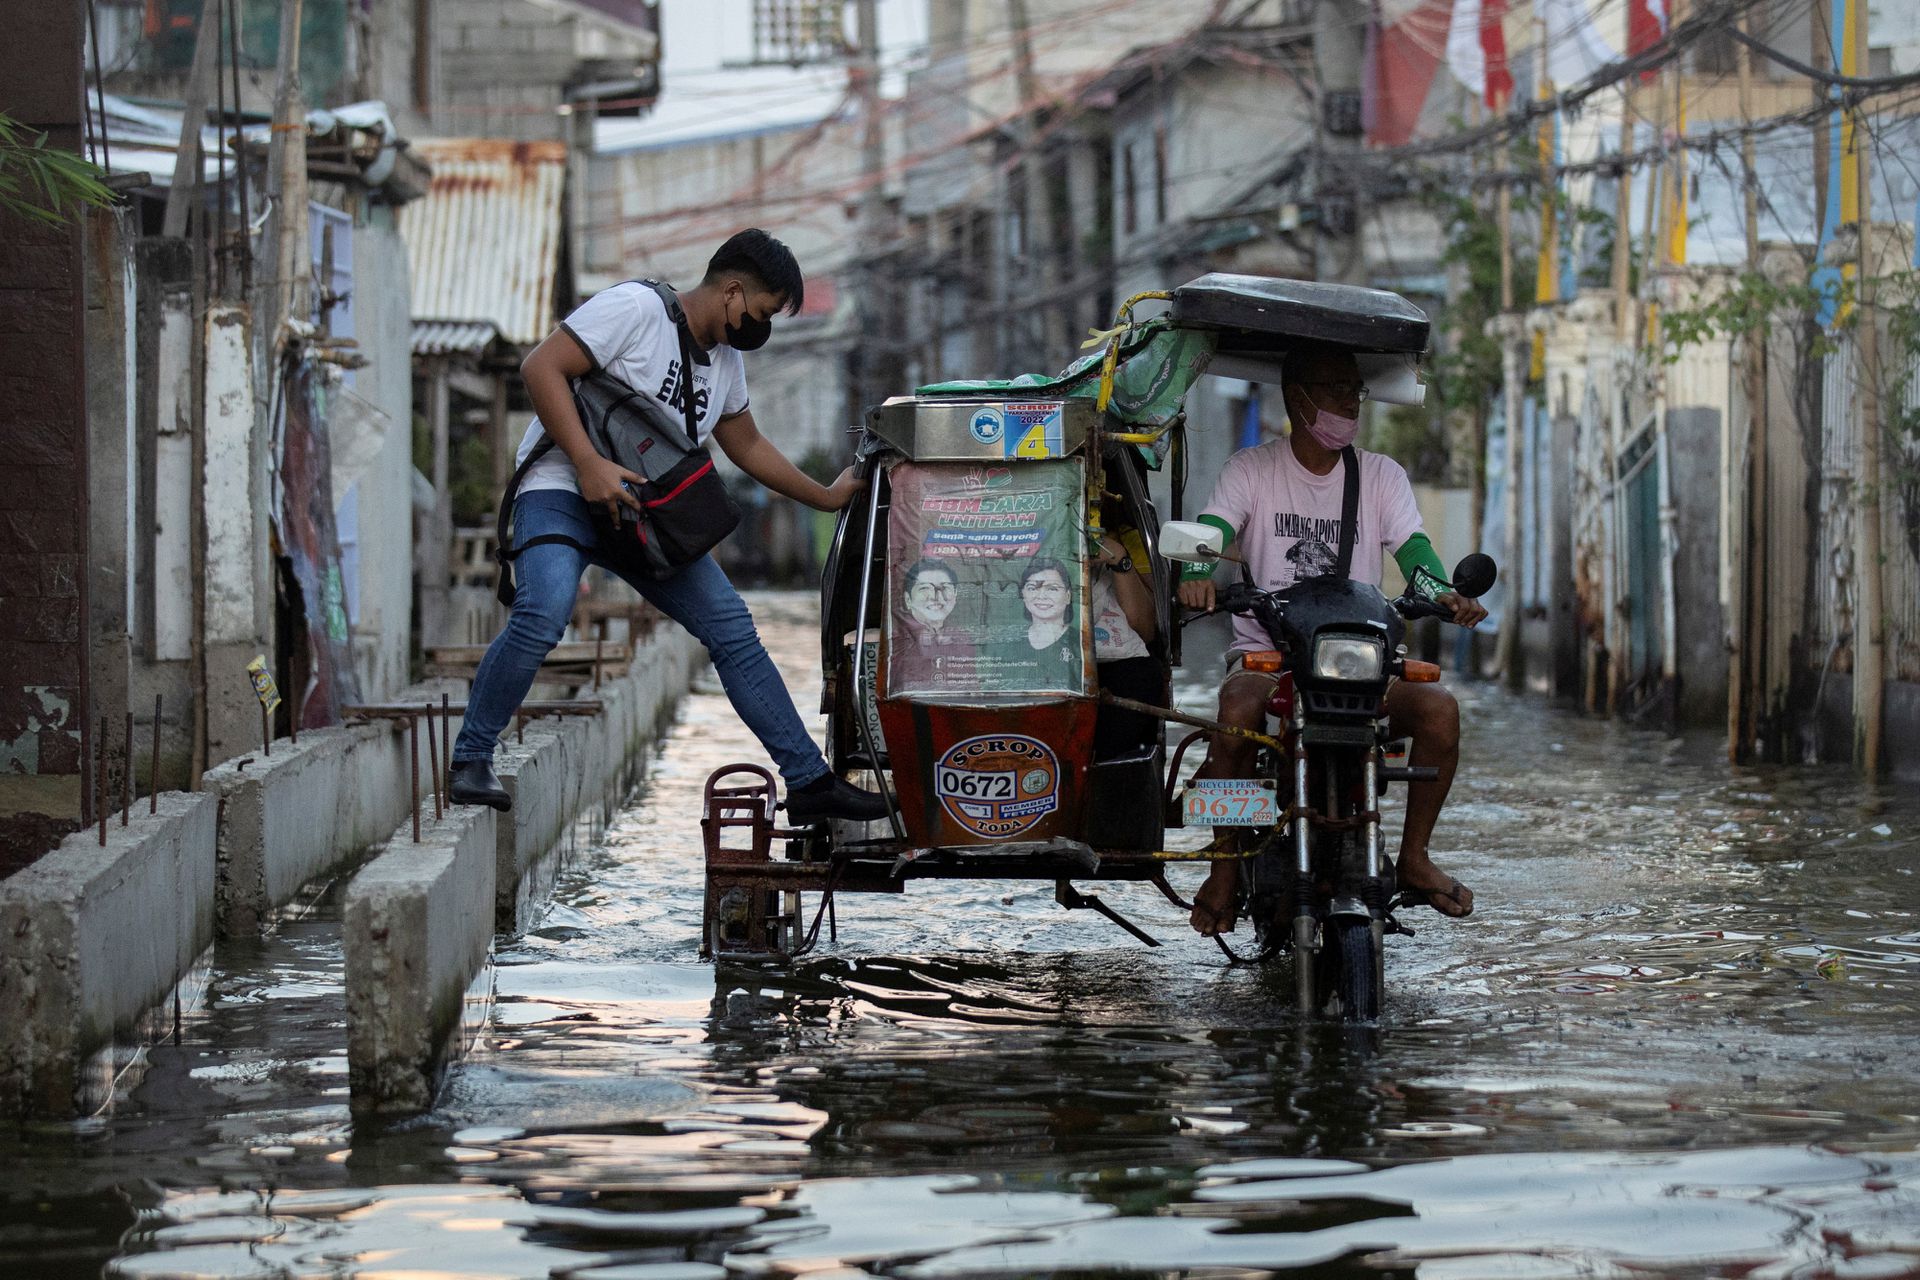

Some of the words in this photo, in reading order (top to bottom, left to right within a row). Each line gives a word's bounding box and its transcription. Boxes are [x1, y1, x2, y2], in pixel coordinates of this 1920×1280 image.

[1021, 416, 1044, 424] 2022
[1017, 423, 1050, 460] 4
[938, 512, 1037, 528] UNITEAM
[1312, 519, 1360, 545] APOSTS
[867, 643, 877, 690] FOLLOW
[869, 695, 876, 709] US
[870, 713, 880, 732] ON
[952, 740, 1044, 766] SCROP
[943, 772, 1012, 797] 0672
[1198, 781, 1234, 789] RICYCLE
[1236, 781, 1260, 789] PERM
[982, 807, 989, 816] 1
[1003, 797, 1052, 811] MEMBER
[1003, 805, 1052, 818] FETODA
[1188, 797, 1270, 817] 0672
[1253, 812, 1271, 821] 2022
[978, 820, 1023, 832] TODA
